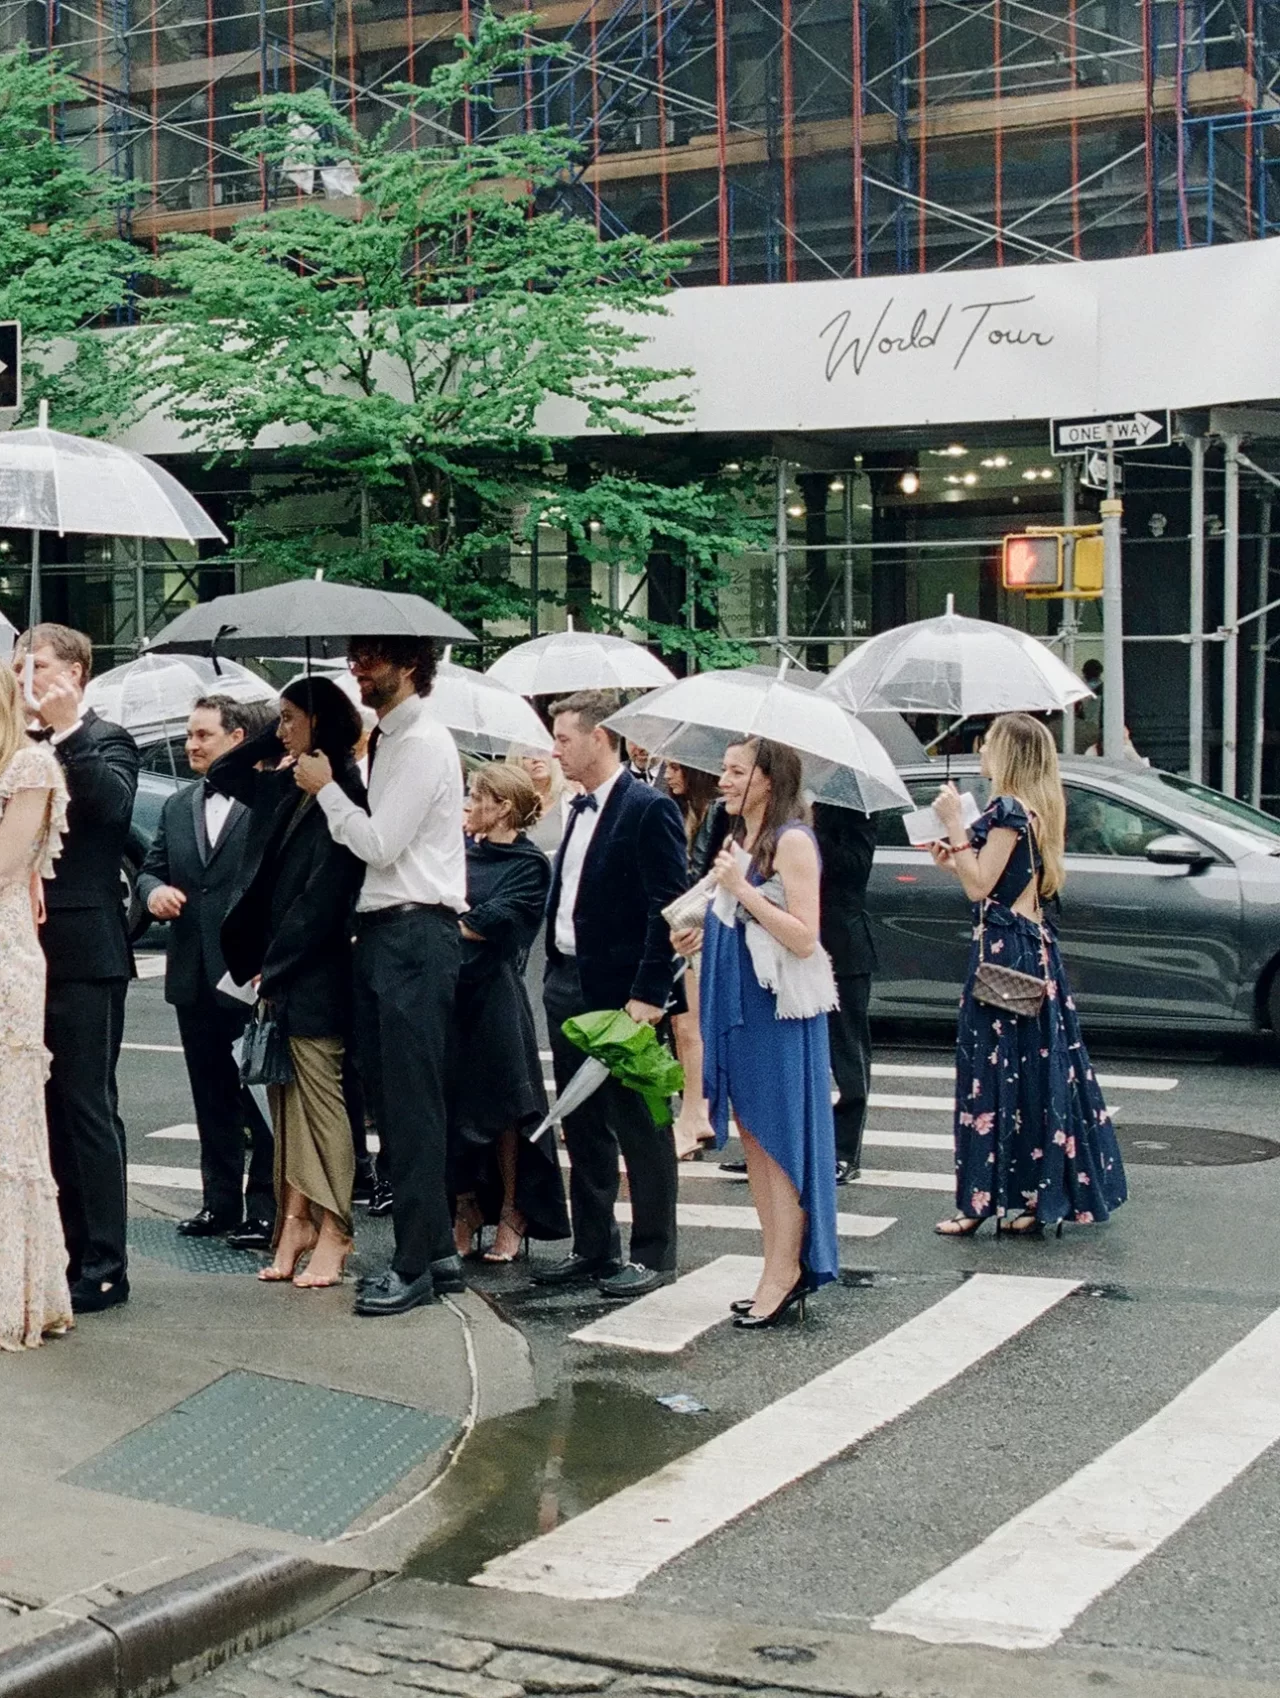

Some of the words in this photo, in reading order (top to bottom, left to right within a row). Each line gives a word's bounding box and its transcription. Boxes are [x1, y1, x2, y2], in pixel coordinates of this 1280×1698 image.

[818, 297, 953, 382] World
[953, 295, 1055, 371] Tour
[1068, 426, 1102, 442] ONE
[1117, 421, 1151, 438] WAY
